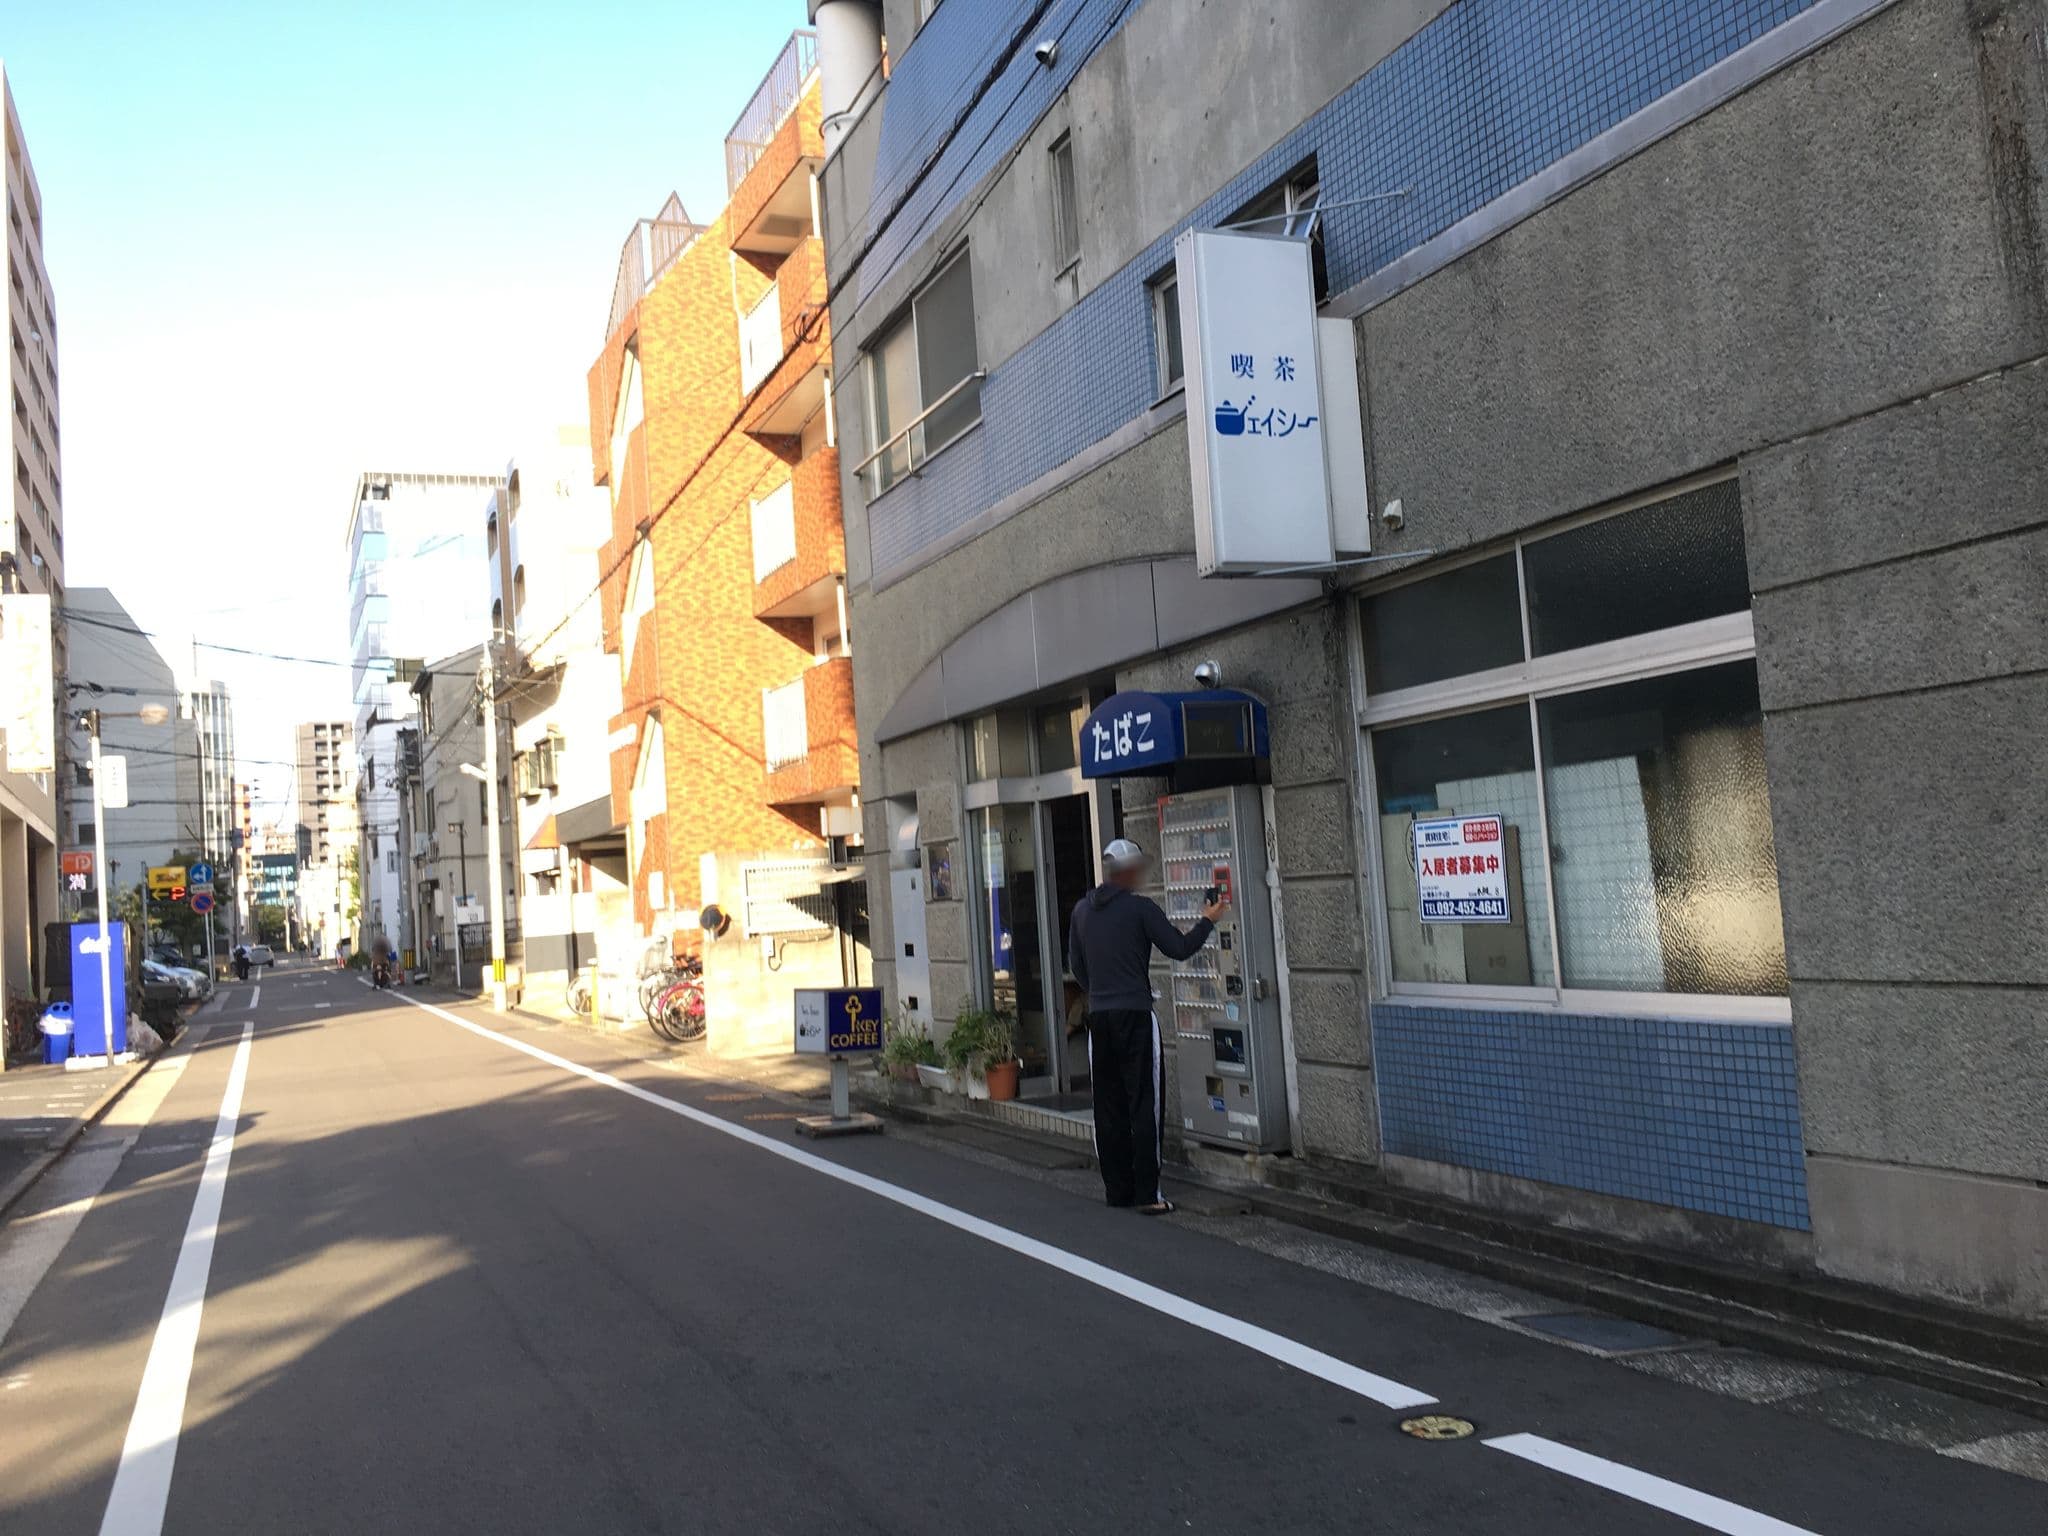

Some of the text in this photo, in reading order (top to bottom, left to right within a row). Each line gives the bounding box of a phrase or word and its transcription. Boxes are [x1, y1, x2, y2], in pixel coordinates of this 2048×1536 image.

[1231, 353, 1295, 382] 喫茶
[1092, 711, 1154, 763] たばこ
[1422, 855, 1499, 877] 入居者募集中
[1425, 902, 1436, 915] TEL
[855, 1018, 879, 1033] KEY
[831, 1032, 879, 1048] COFFEE
